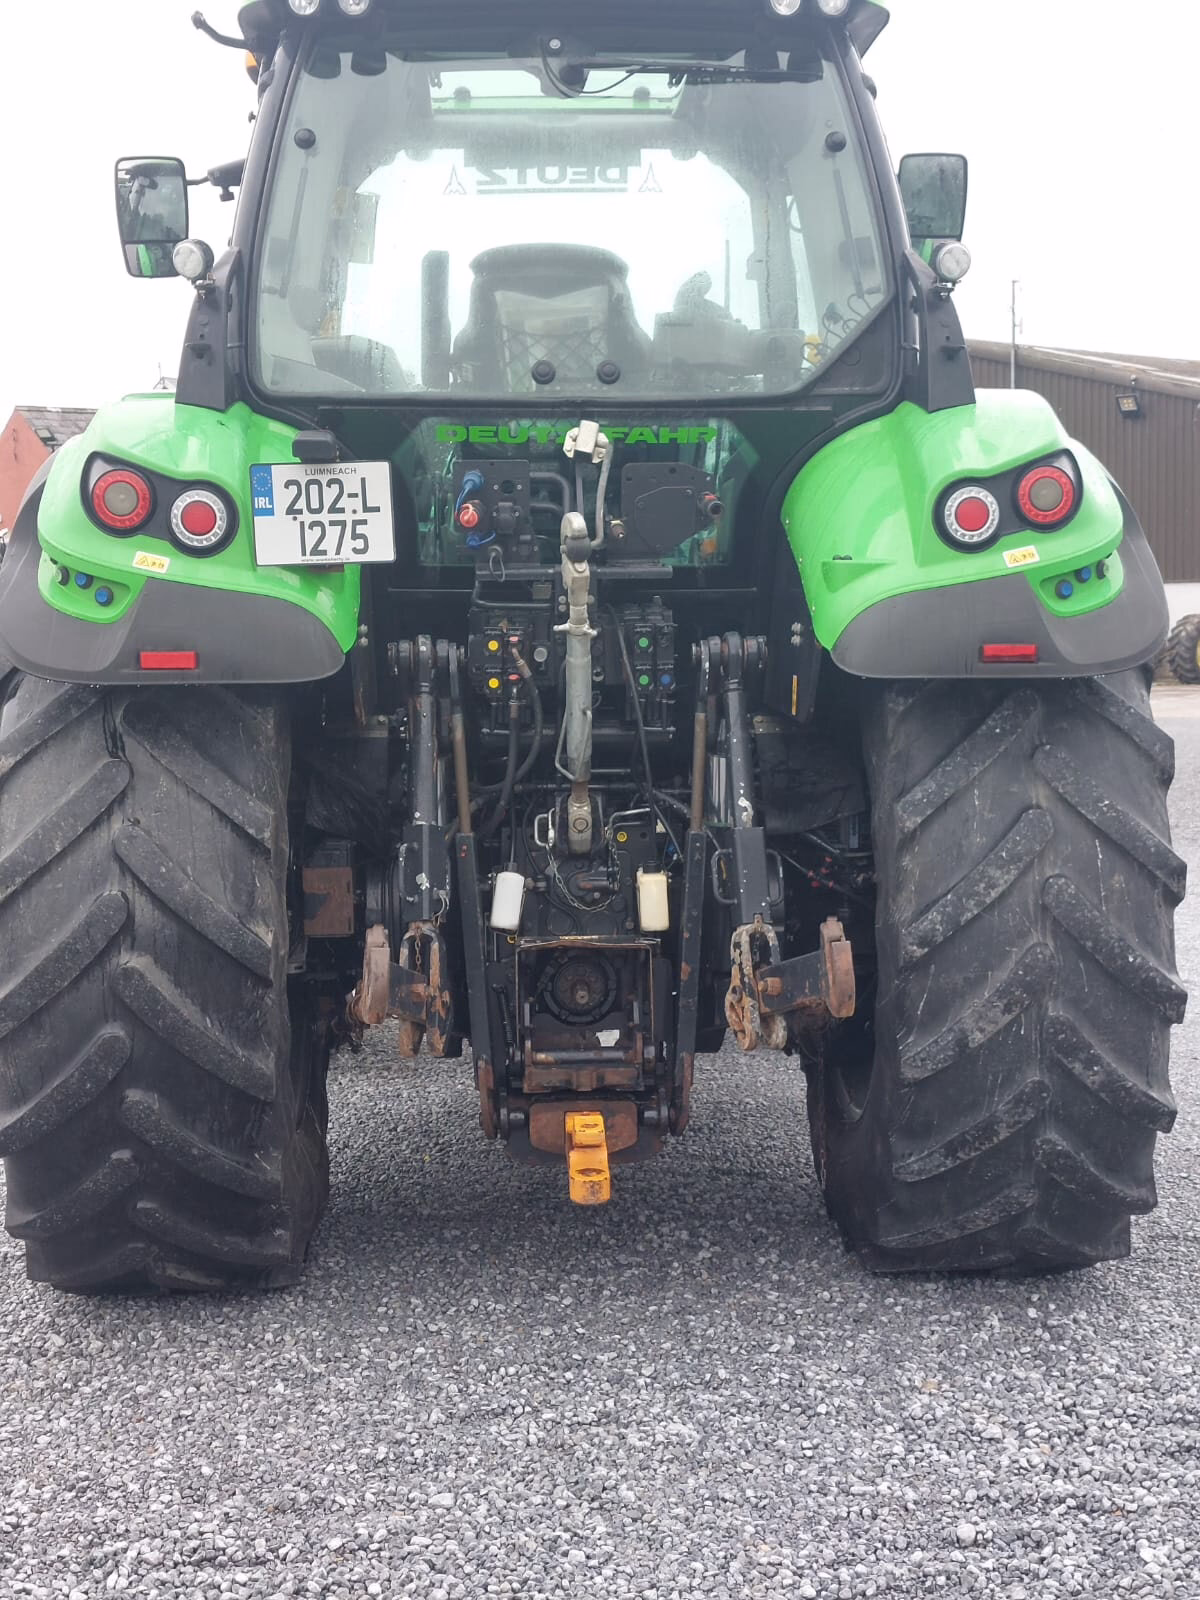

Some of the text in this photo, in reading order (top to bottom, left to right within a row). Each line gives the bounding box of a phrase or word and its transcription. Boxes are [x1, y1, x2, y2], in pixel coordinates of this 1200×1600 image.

[305, 467, 357, 476] LUIMNEACH
[254, 497, 272, 509] IRL
[284, 477, 381, 516] 202-L
[299, 518, 369, 557] 1275
